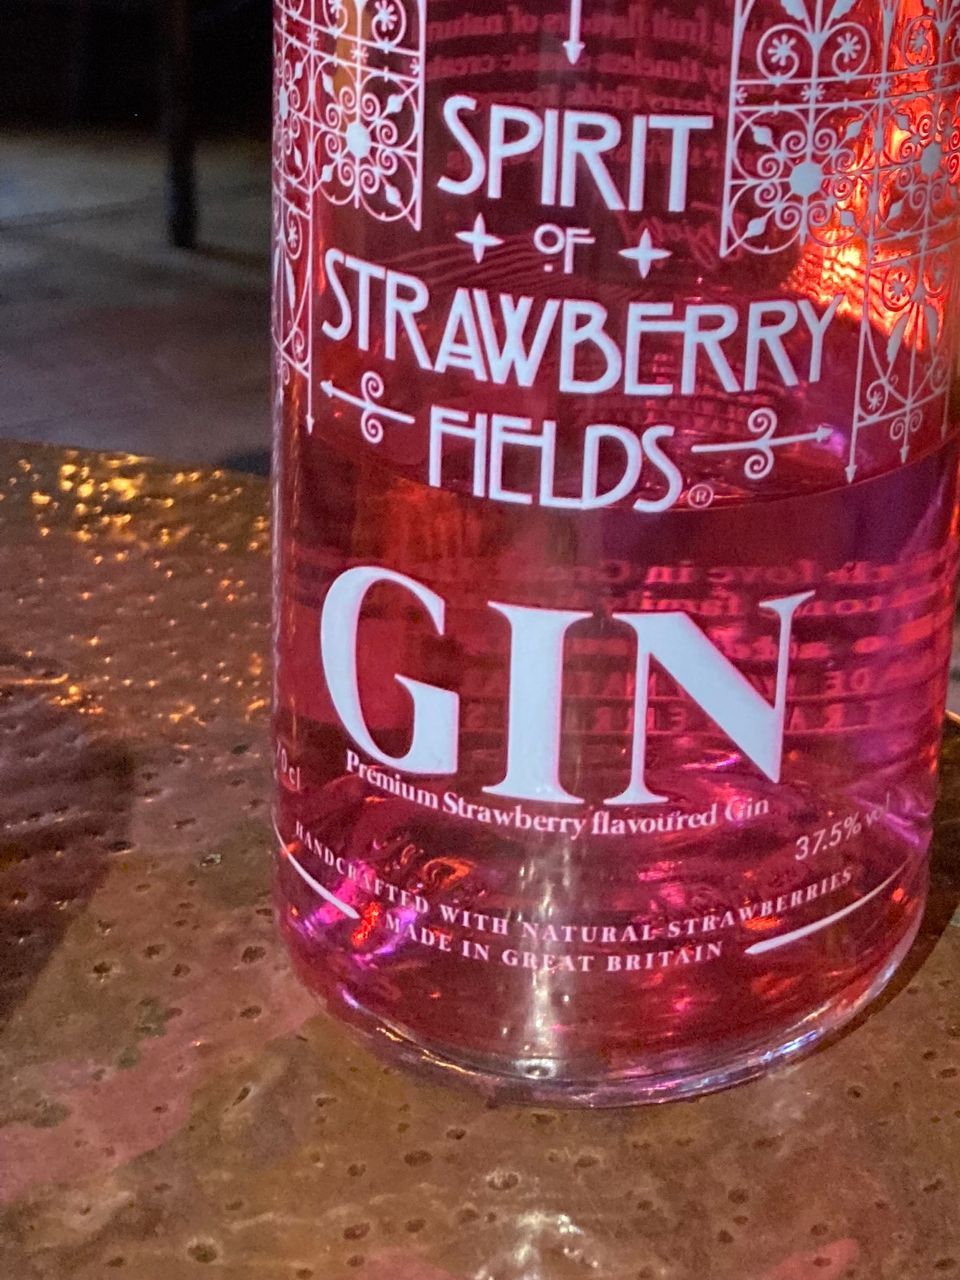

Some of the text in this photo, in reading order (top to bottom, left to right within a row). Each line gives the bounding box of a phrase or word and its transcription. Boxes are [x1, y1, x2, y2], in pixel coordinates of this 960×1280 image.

[437, 94, 714, 213] SPIRIT
[532, 222, 596, 275] OF
[321, 248, 843, 396] STRAWBERRY
[320, 565, 816, 805] GIN
[346, 748, 770, 841] Premium Strawberry flavoured Gin
[795, 811, 862, 861] 37.5%
[295, 820, 853, 943] HANDCRAFTED WITH NATURAL STRAWBERRIES
[384, 914, 724, 972] MADE IN GREAT BRITAIN
